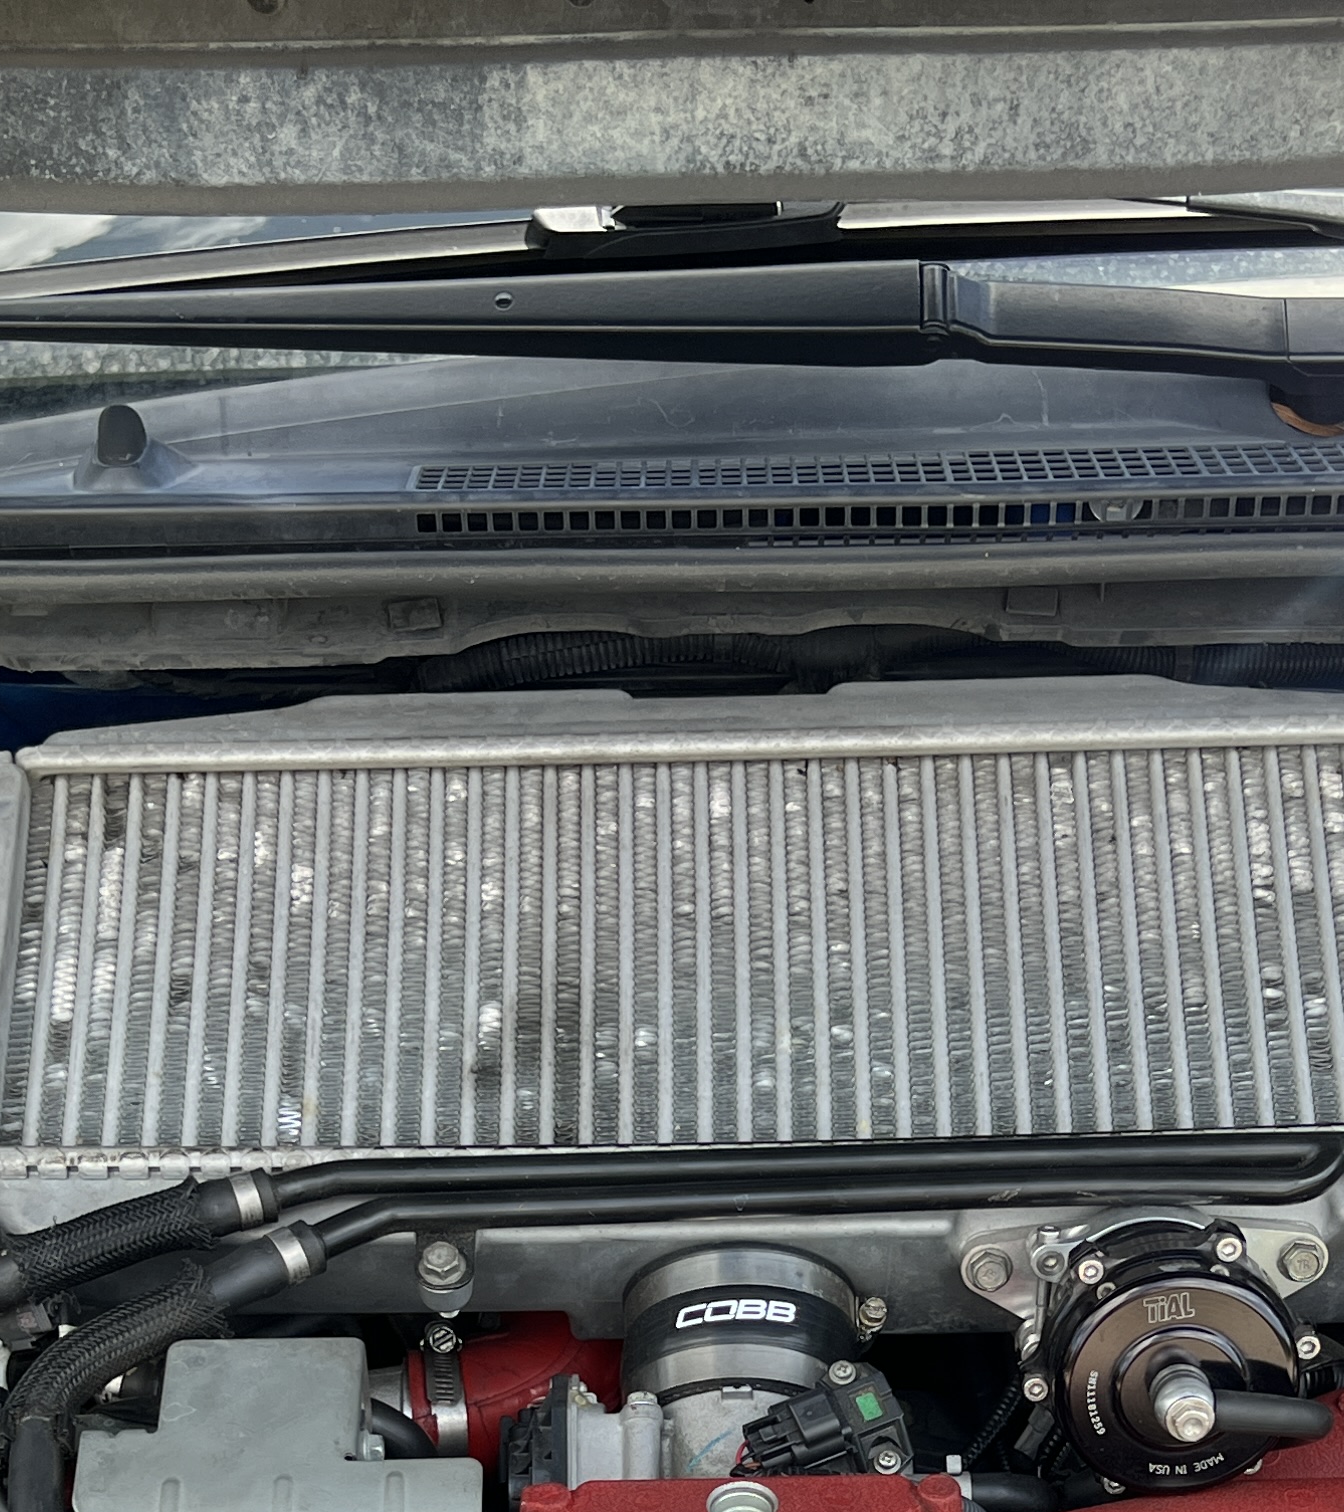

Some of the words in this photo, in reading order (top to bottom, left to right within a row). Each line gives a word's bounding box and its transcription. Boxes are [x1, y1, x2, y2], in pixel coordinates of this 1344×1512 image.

[676, 1299, 797, 1329] COBB
[1148, 1461, 1170, 1476] USA
[1174, 1463, 1188, 1476] IN
[1193, 1452, 1225, 1473] MADE
